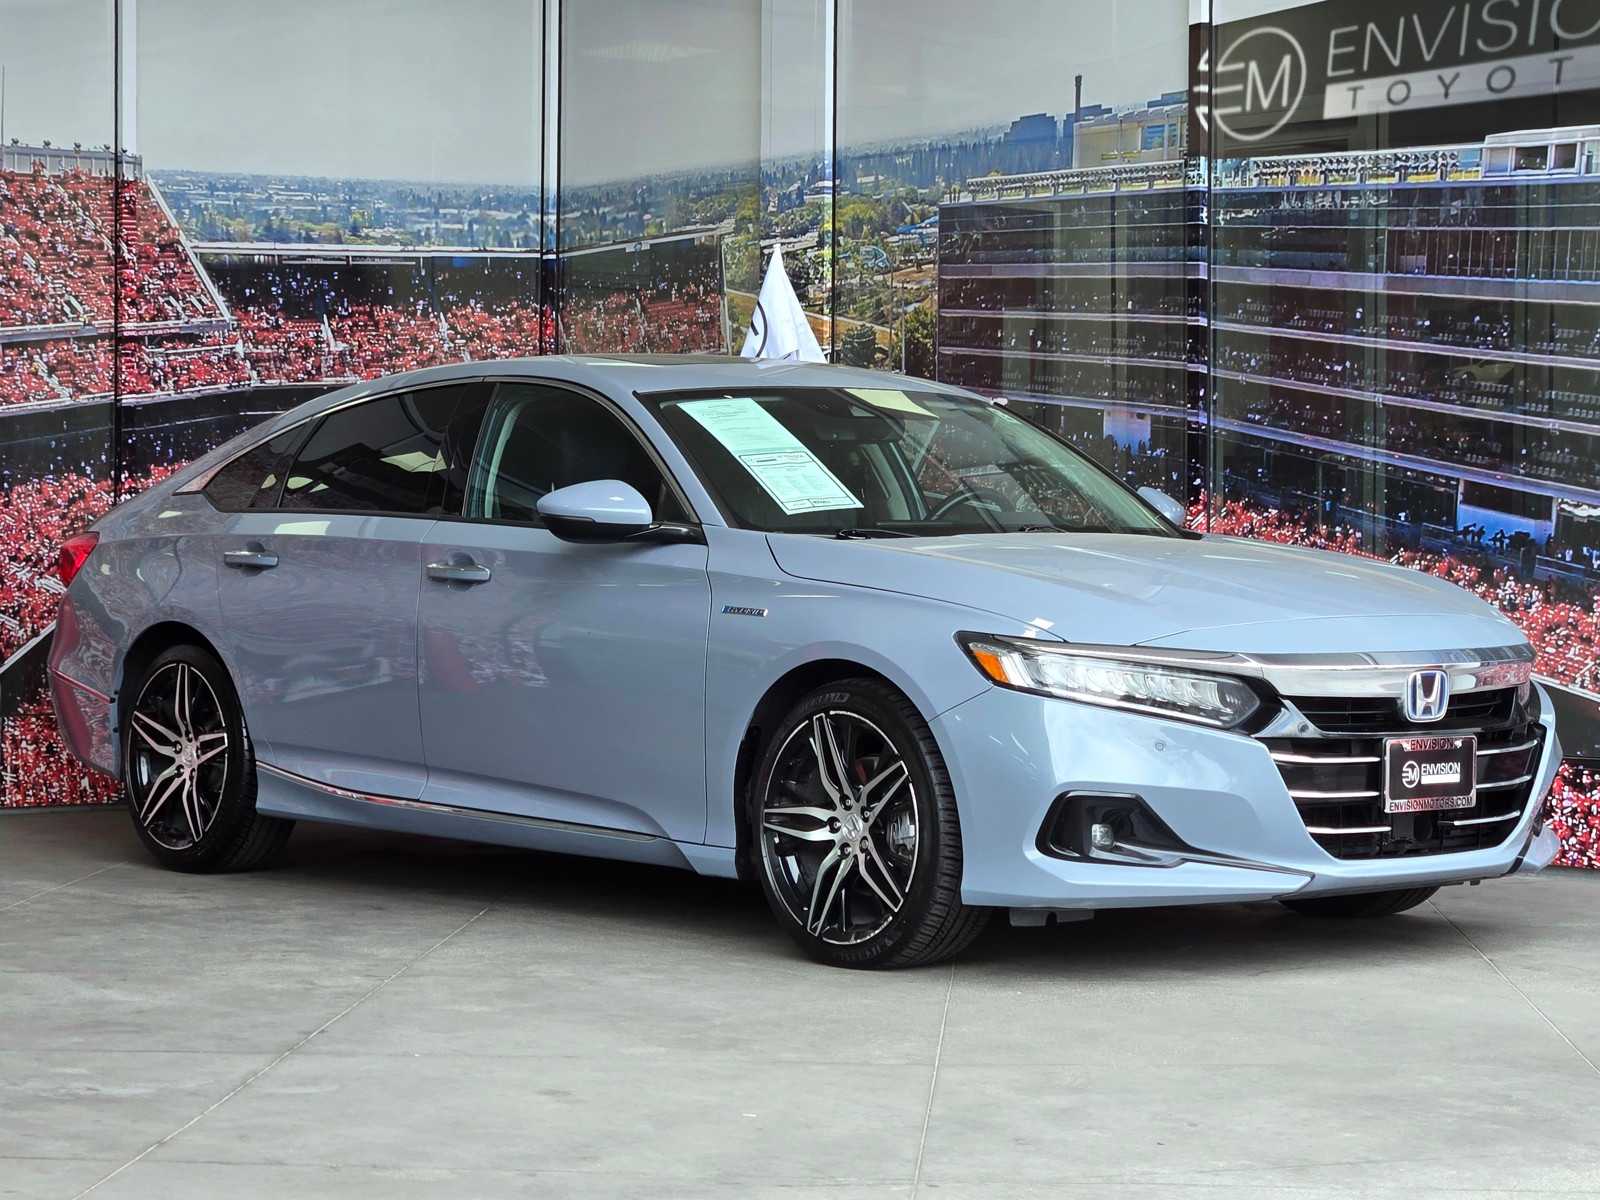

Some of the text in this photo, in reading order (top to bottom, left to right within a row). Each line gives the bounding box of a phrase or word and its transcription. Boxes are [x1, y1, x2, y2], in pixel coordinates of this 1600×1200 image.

[1410, 738, 1455, 751] ENVISION
[1421, 762, 1460, 776] ENVISION
[1389, 796, 1473, 812] ENVISIONMOTORS.COM
